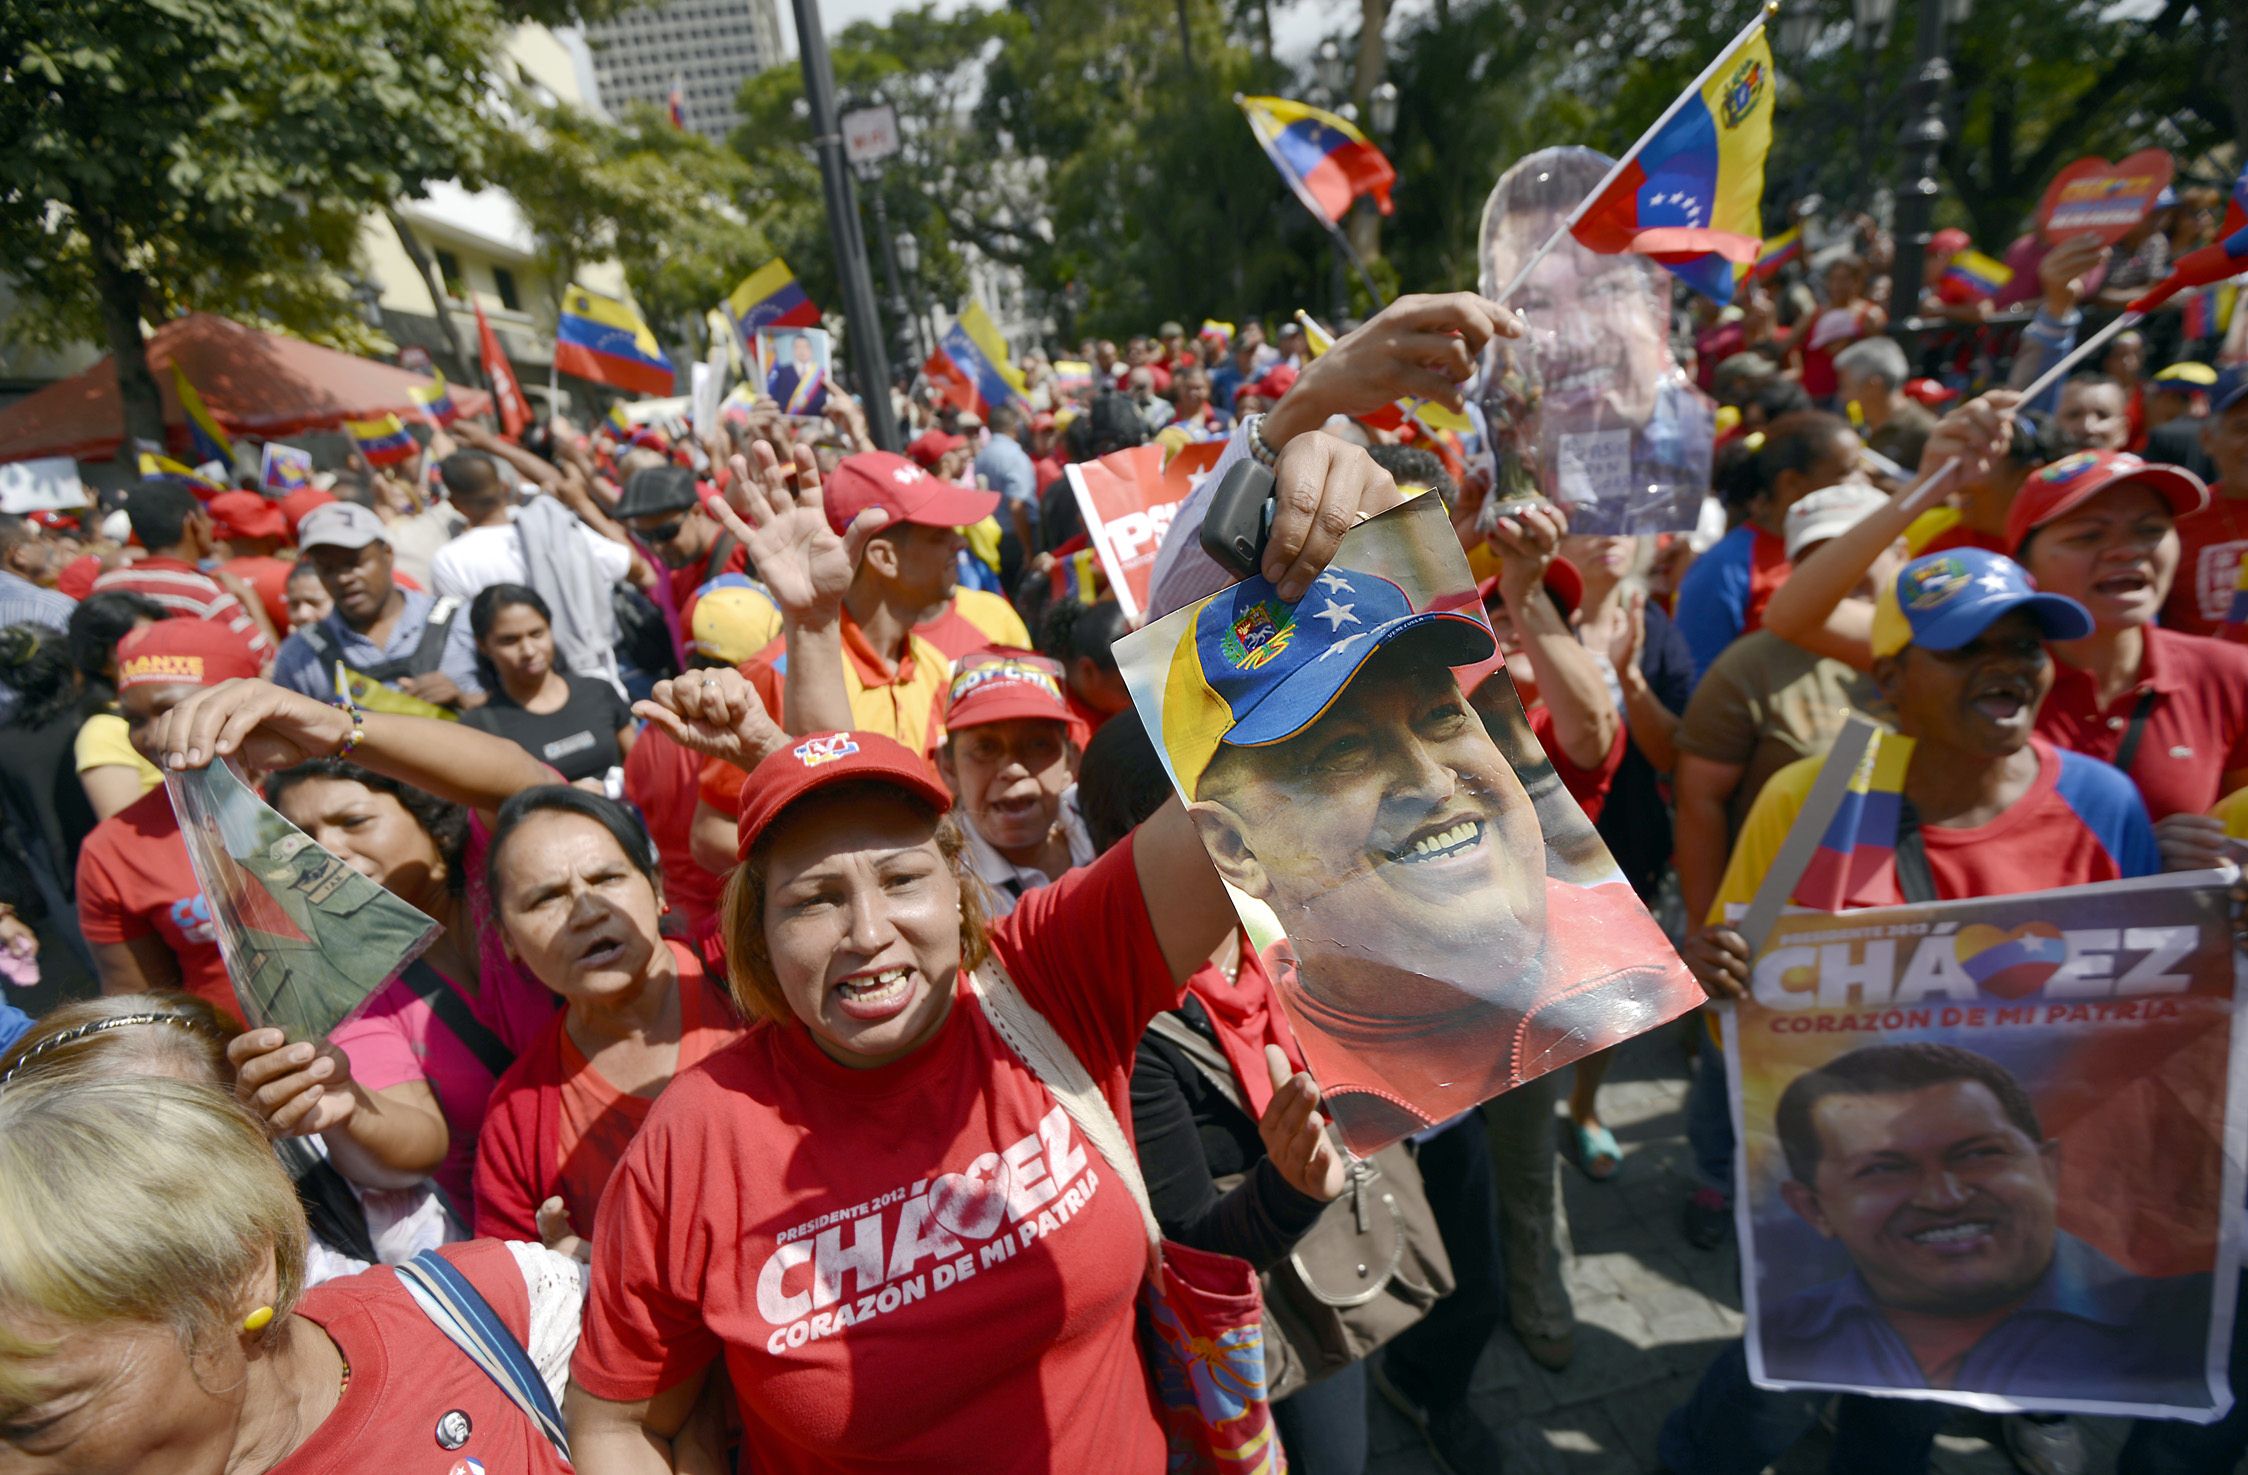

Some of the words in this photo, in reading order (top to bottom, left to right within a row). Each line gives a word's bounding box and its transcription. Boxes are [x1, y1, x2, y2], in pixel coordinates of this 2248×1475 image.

[1104, 500, 1184, 562] PS
[1769, 1007, 1931, 1033] CORAZÓN
[1941, 1007, 1985, 1027] DE
[1995, 1005, 2037, 1026] MI
[2044, 1000, 2178, 1024] PATRIA
[776, 1202, 869, 1245] PRESIDENTE
[871, 1187, 906, 1212] 2012
[767, 1274, 926, 1355] CORAZÓN
[932, 1253, 976, 1292] DE
[980, 1233, 1017, 1270] MI
[1018, 1167, 1100, 1248] PATRIA
